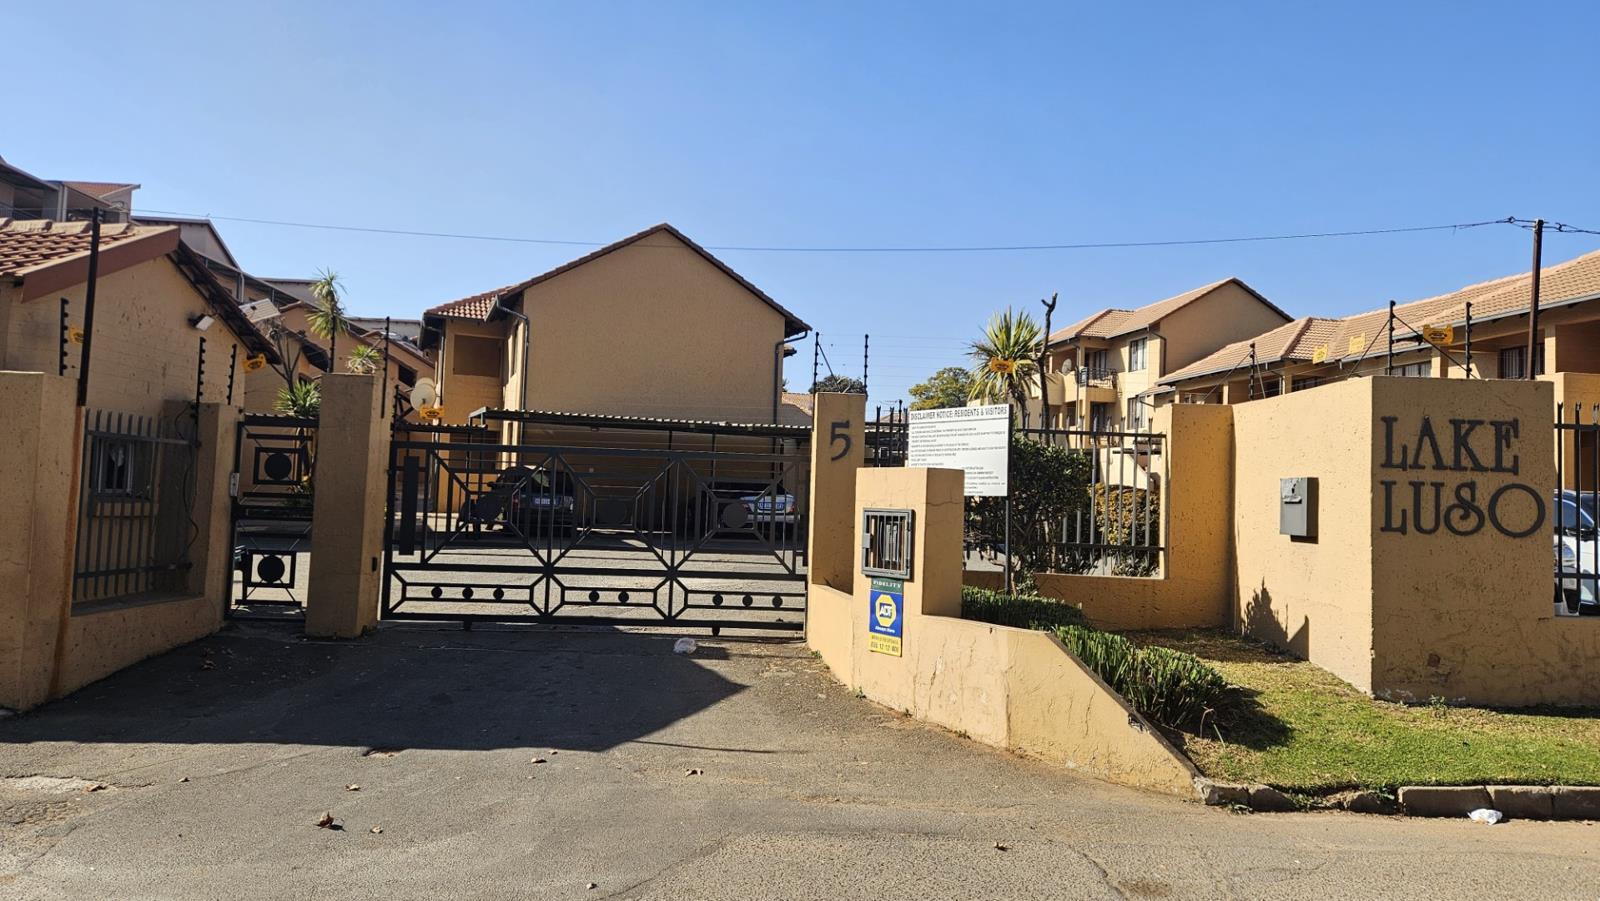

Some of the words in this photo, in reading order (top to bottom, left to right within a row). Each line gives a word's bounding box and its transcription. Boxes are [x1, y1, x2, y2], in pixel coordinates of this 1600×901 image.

[830, 420, 851, 461] 5
[1380, 415, 1519, 476] LAKE
[1380, 480, 1546, 538] LUSO
[873, 580, 901, 588] FIDELITY
